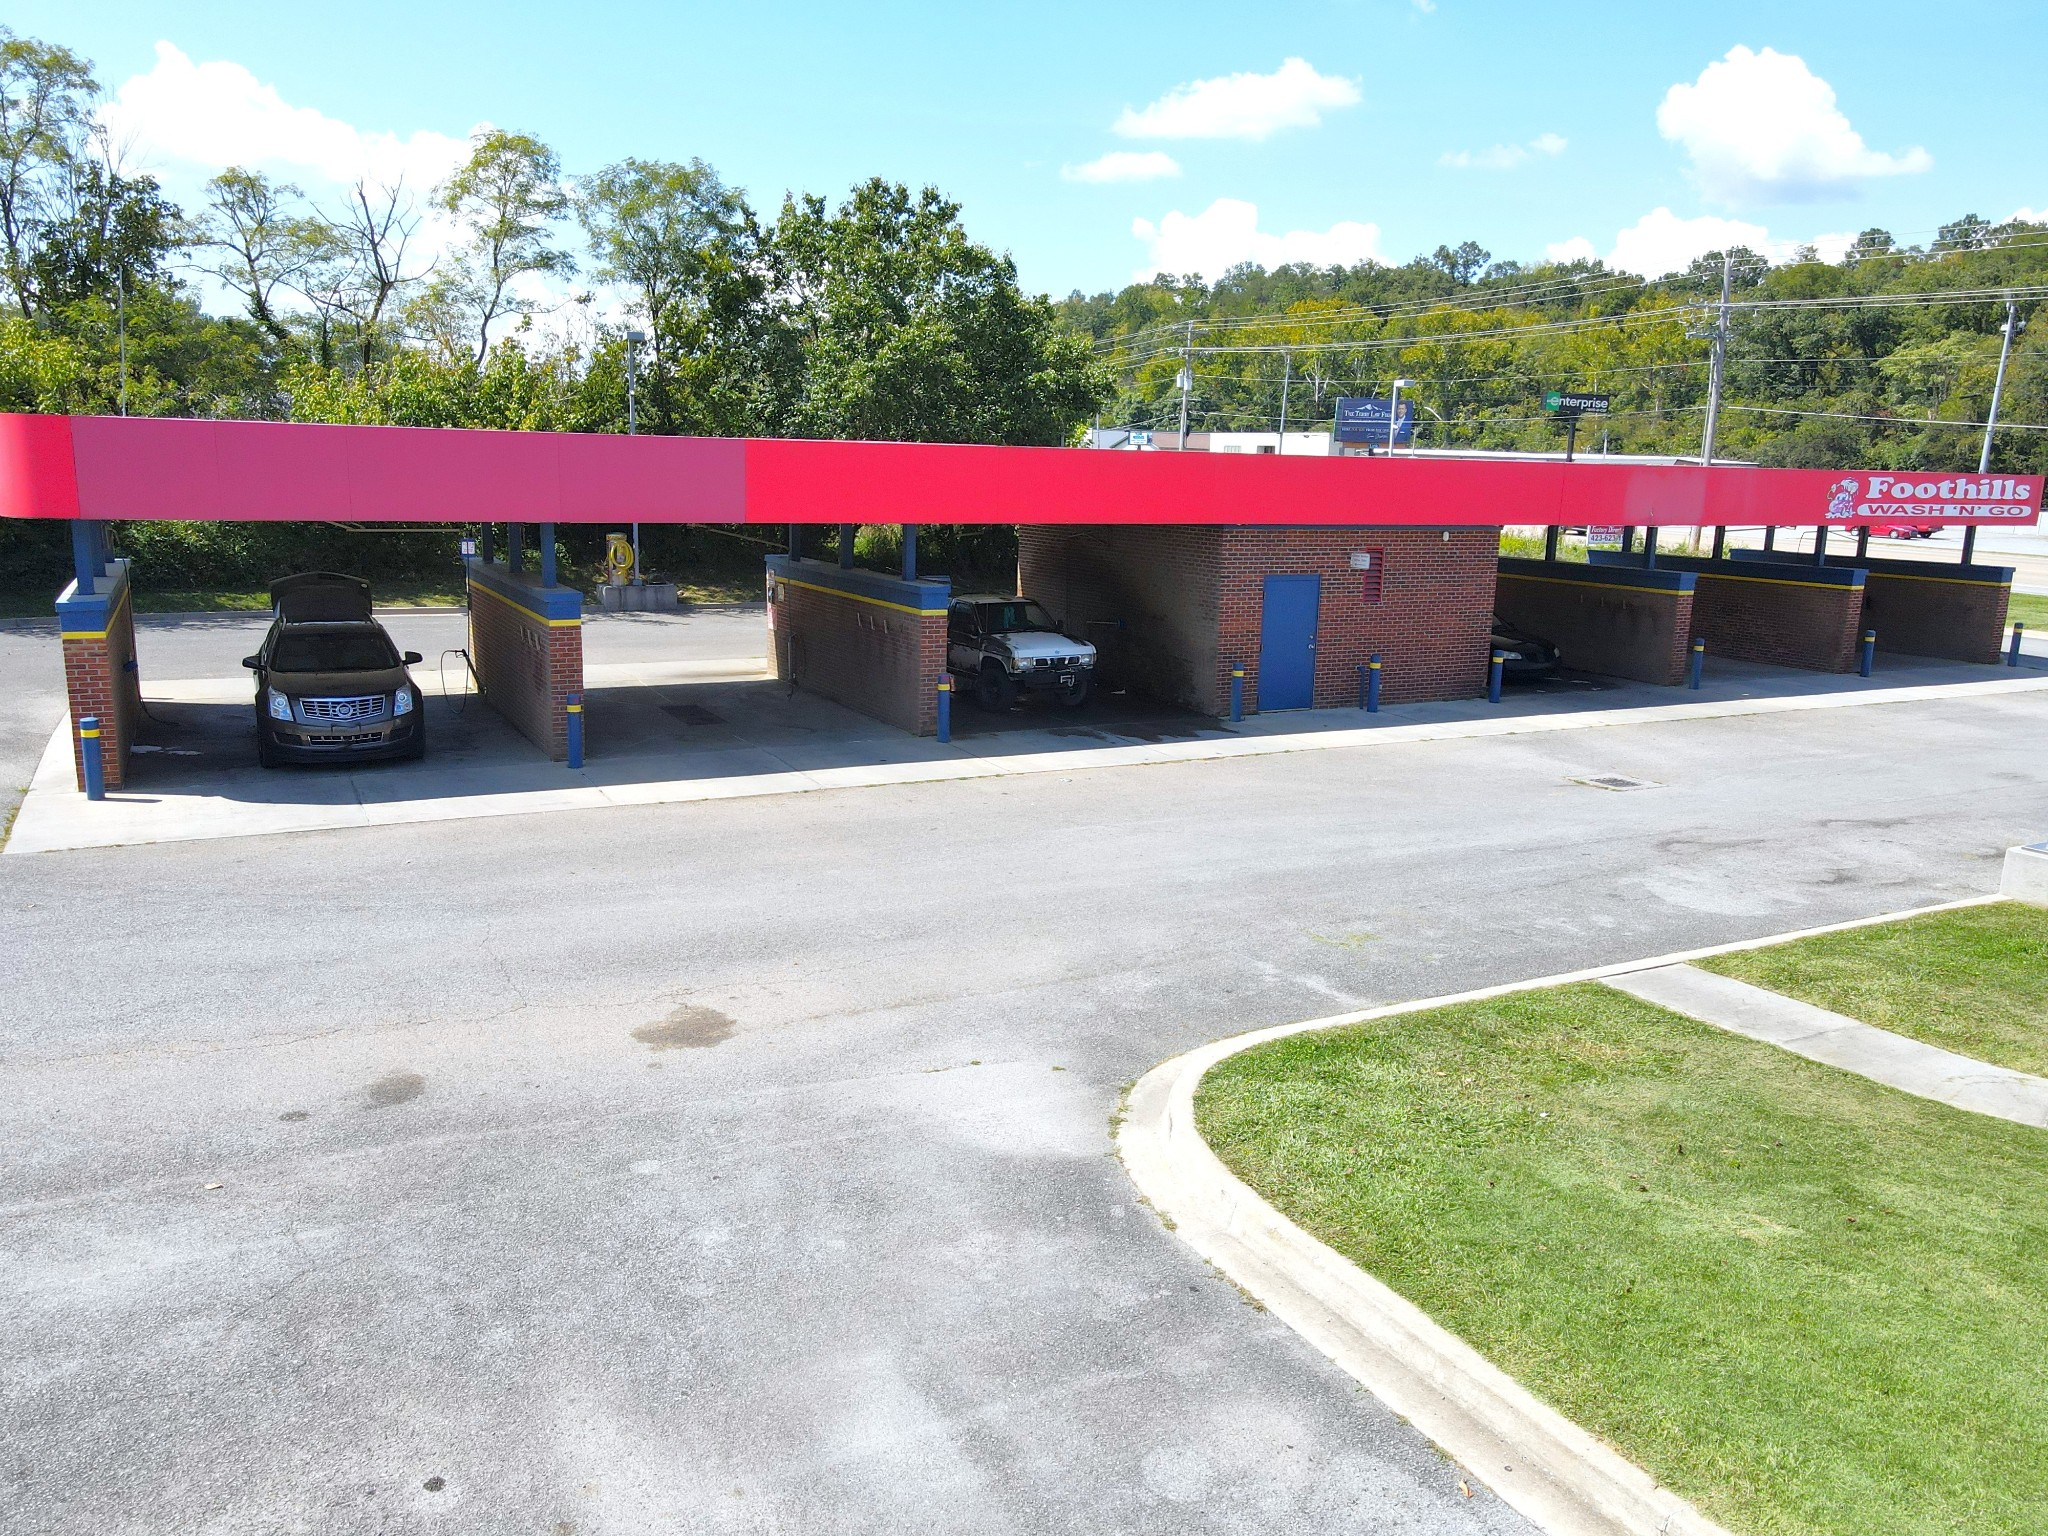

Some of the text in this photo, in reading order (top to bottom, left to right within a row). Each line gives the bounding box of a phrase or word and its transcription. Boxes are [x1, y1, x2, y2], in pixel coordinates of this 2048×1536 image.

[1547, 396, 1608, 410] enterprise
[1865, 476, 2031, 500] Foothills
[1867, 504, 1940, 516] WASH
[1988, 505, 2023, 516] GO
[1591, 525, 1607, 534] Factory
